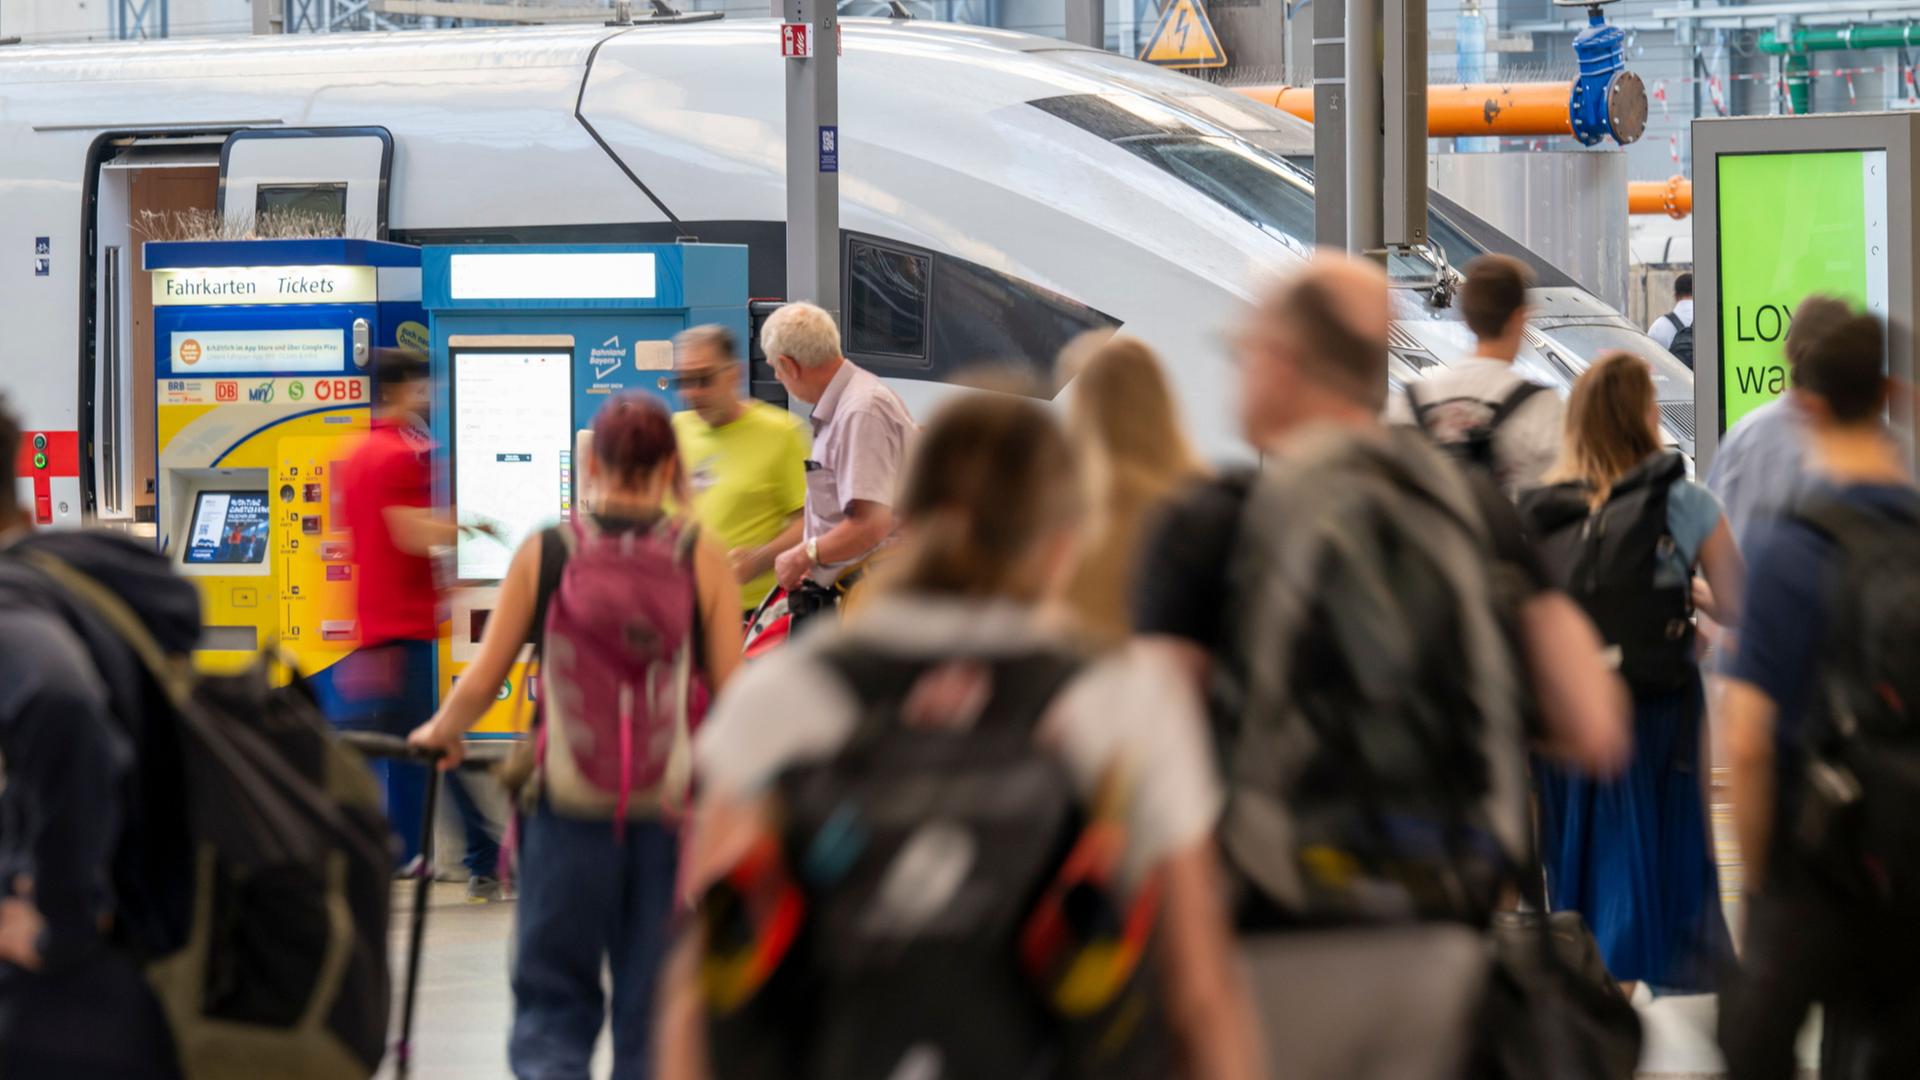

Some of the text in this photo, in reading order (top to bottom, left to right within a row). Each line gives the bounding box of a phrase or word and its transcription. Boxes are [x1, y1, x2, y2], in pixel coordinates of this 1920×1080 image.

[166, 276, 334, 296] Fahrkarten Tickets
[244, 343, 256, 353] App
[257, 343, 273, 351] Store
[591, 348, 626, 357] Bahnland
[589, 356, 615, 366] Bayern
[168, 381, 185, 391] BRB
[218, 384, 236, 398] DB
[314, 379, 362, 401] ÖBB
